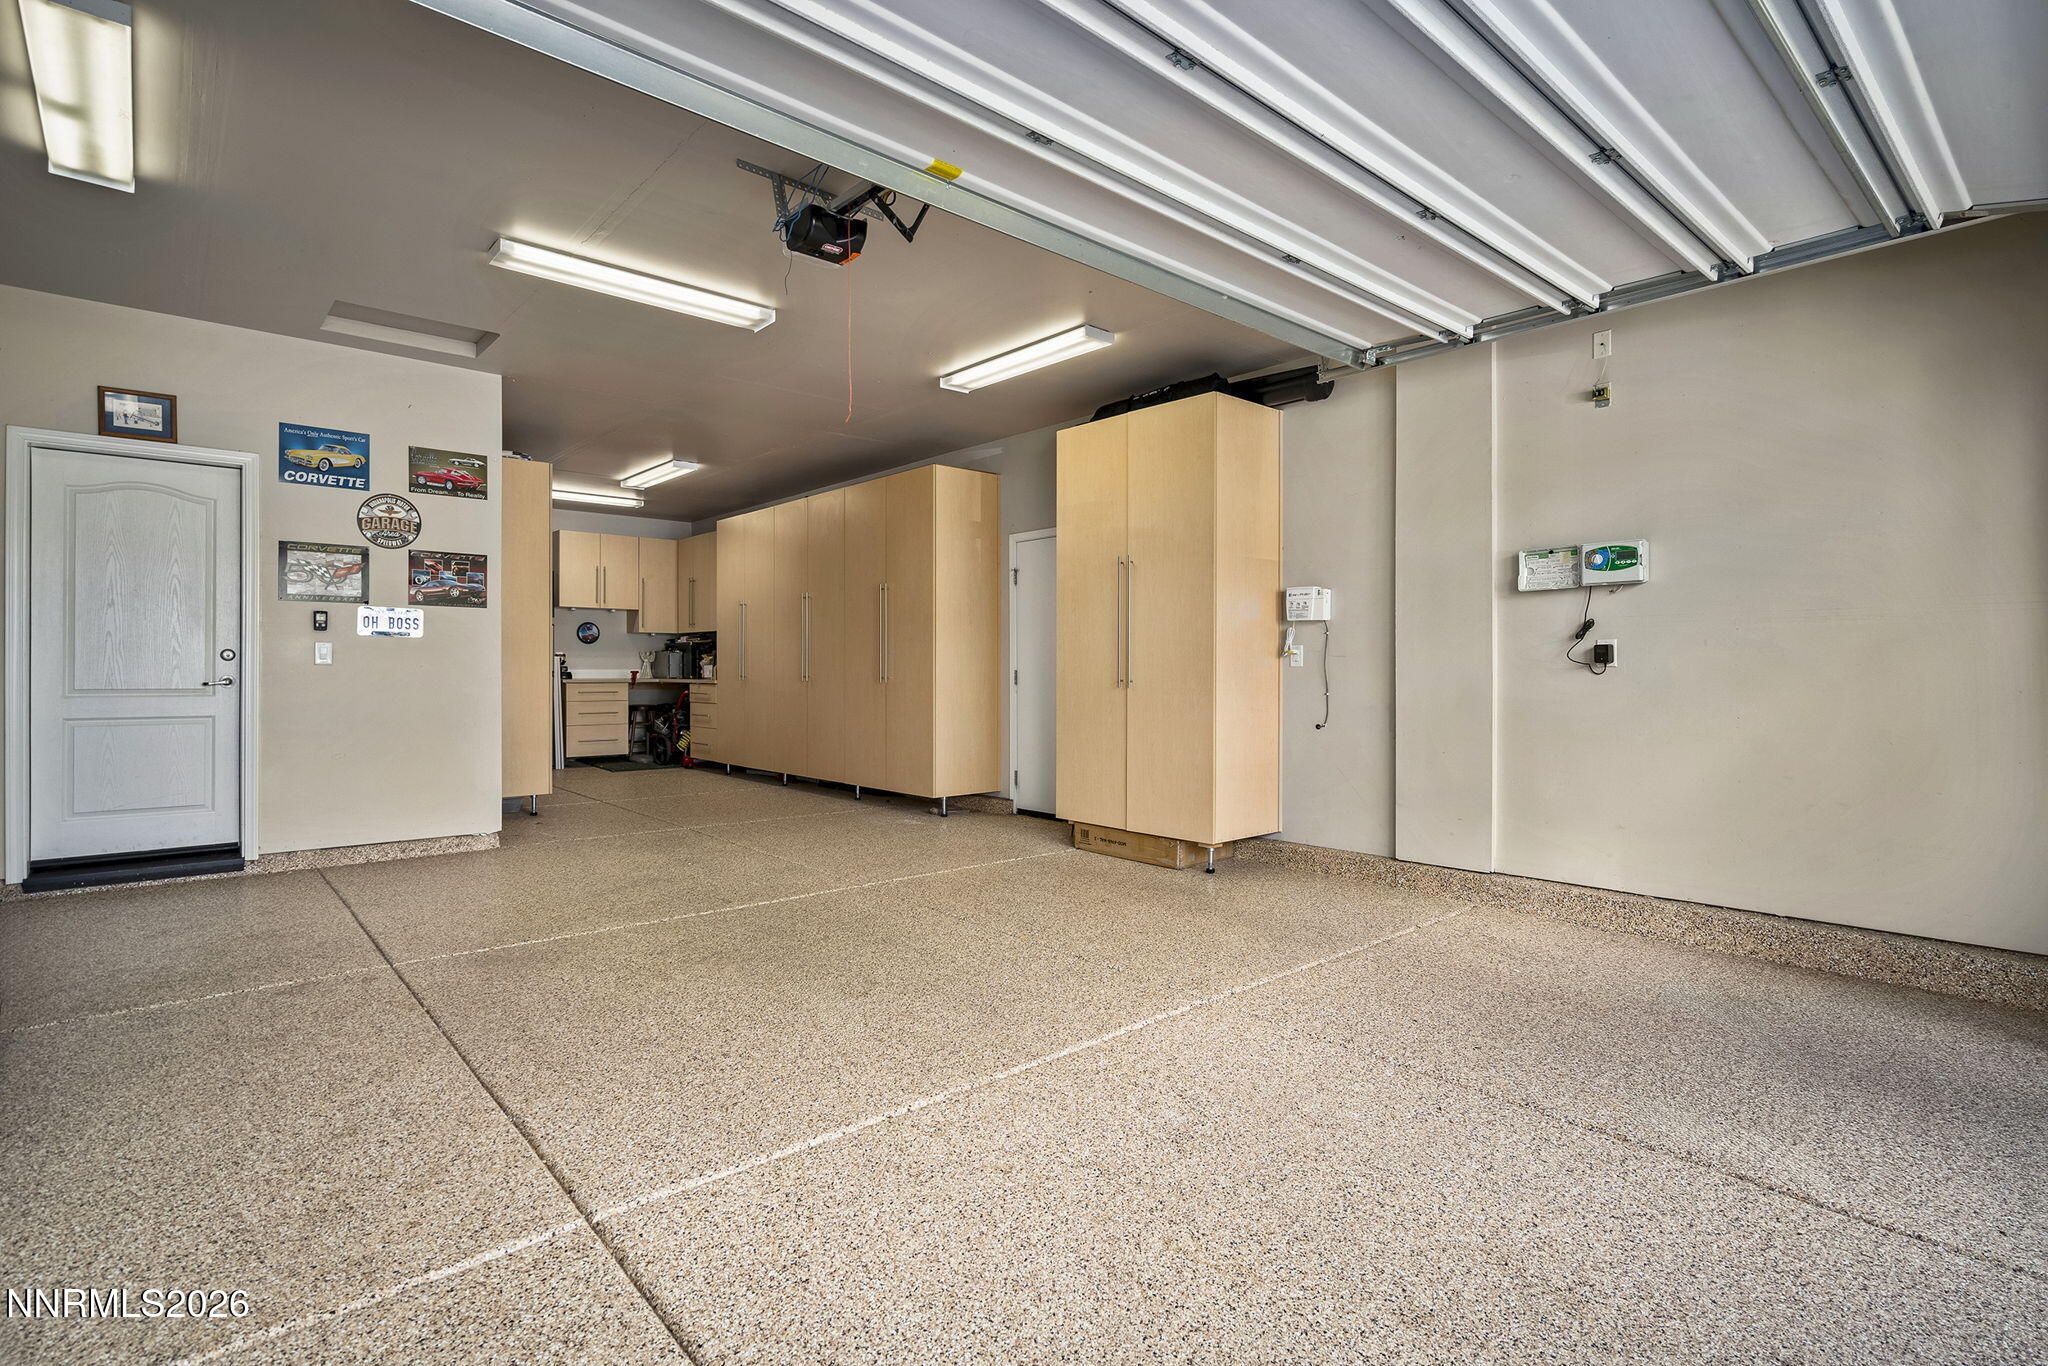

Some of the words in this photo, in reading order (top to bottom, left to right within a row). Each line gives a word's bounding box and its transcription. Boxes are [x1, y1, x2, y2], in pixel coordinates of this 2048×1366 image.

[284, 470, 366, 488] CORVETTE
[361, 517, 419, 535] GARAGE
[287, 543, 362, 553] CORVETTE
[410, 551, 486, 561] CORVETTE
[363, 615, 379, 629] OH
[388, 616, 419, 630] BOSS
